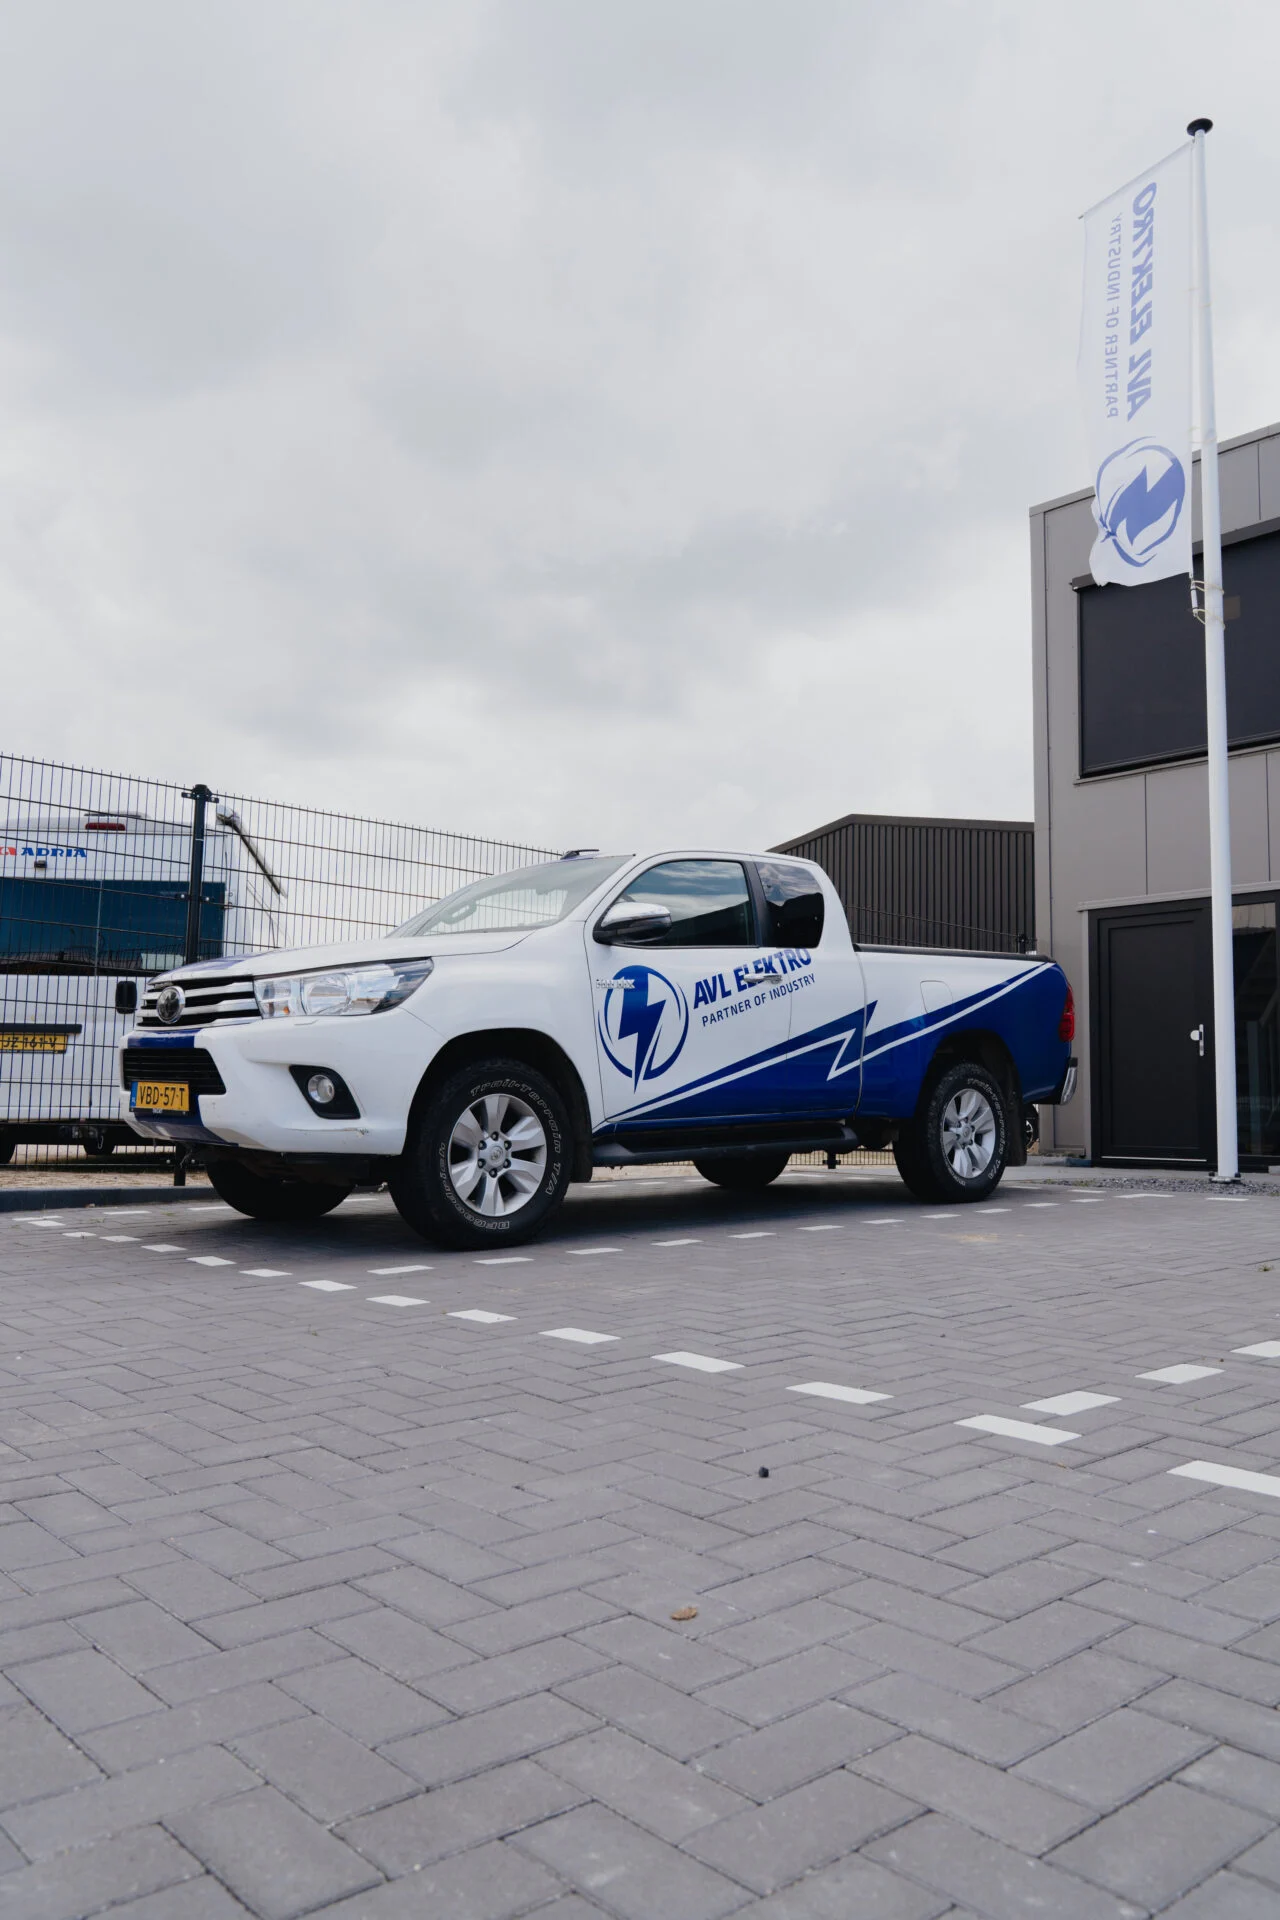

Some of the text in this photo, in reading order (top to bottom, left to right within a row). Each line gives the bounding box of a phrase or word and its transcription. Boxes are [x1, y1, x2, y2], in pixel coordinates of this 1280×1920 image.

[21, 847, 87, 858] ADRIA
[693, 948, 812, 1009] AVL ELEKTRO
[702, 973, 816, 1027] PARTNER OF INDUSTRY
[139, 1086, 185, 1107] VBD-57-T
